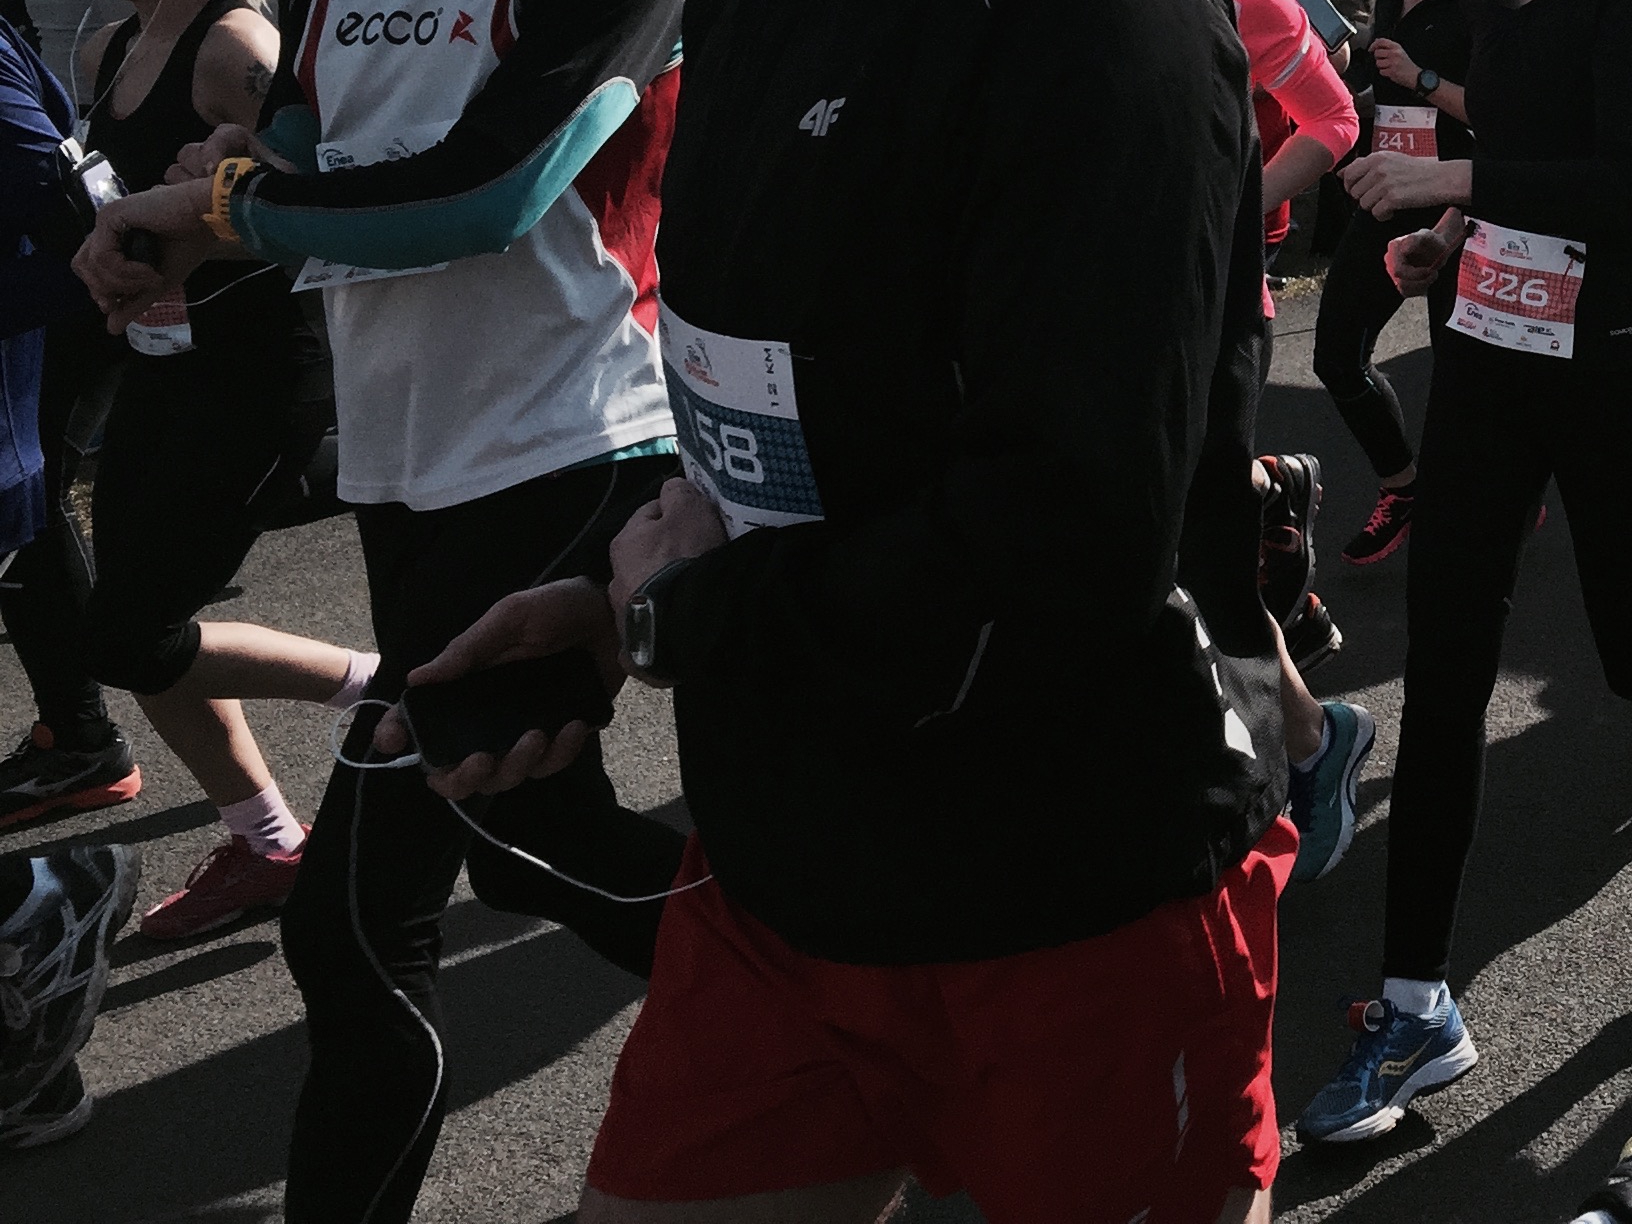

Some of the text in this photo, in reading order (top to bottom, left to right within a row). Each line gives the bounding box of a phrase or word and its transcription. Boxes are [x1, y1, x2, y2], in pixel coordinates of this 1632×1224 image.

[336, 8, 442, 47] ecco
[798, 97, 846, 136] 4F
[1379, 132, 1415, 150] 241
[1477, 265, 1549, 307] 226
[764, 347, 775, 374] KM
